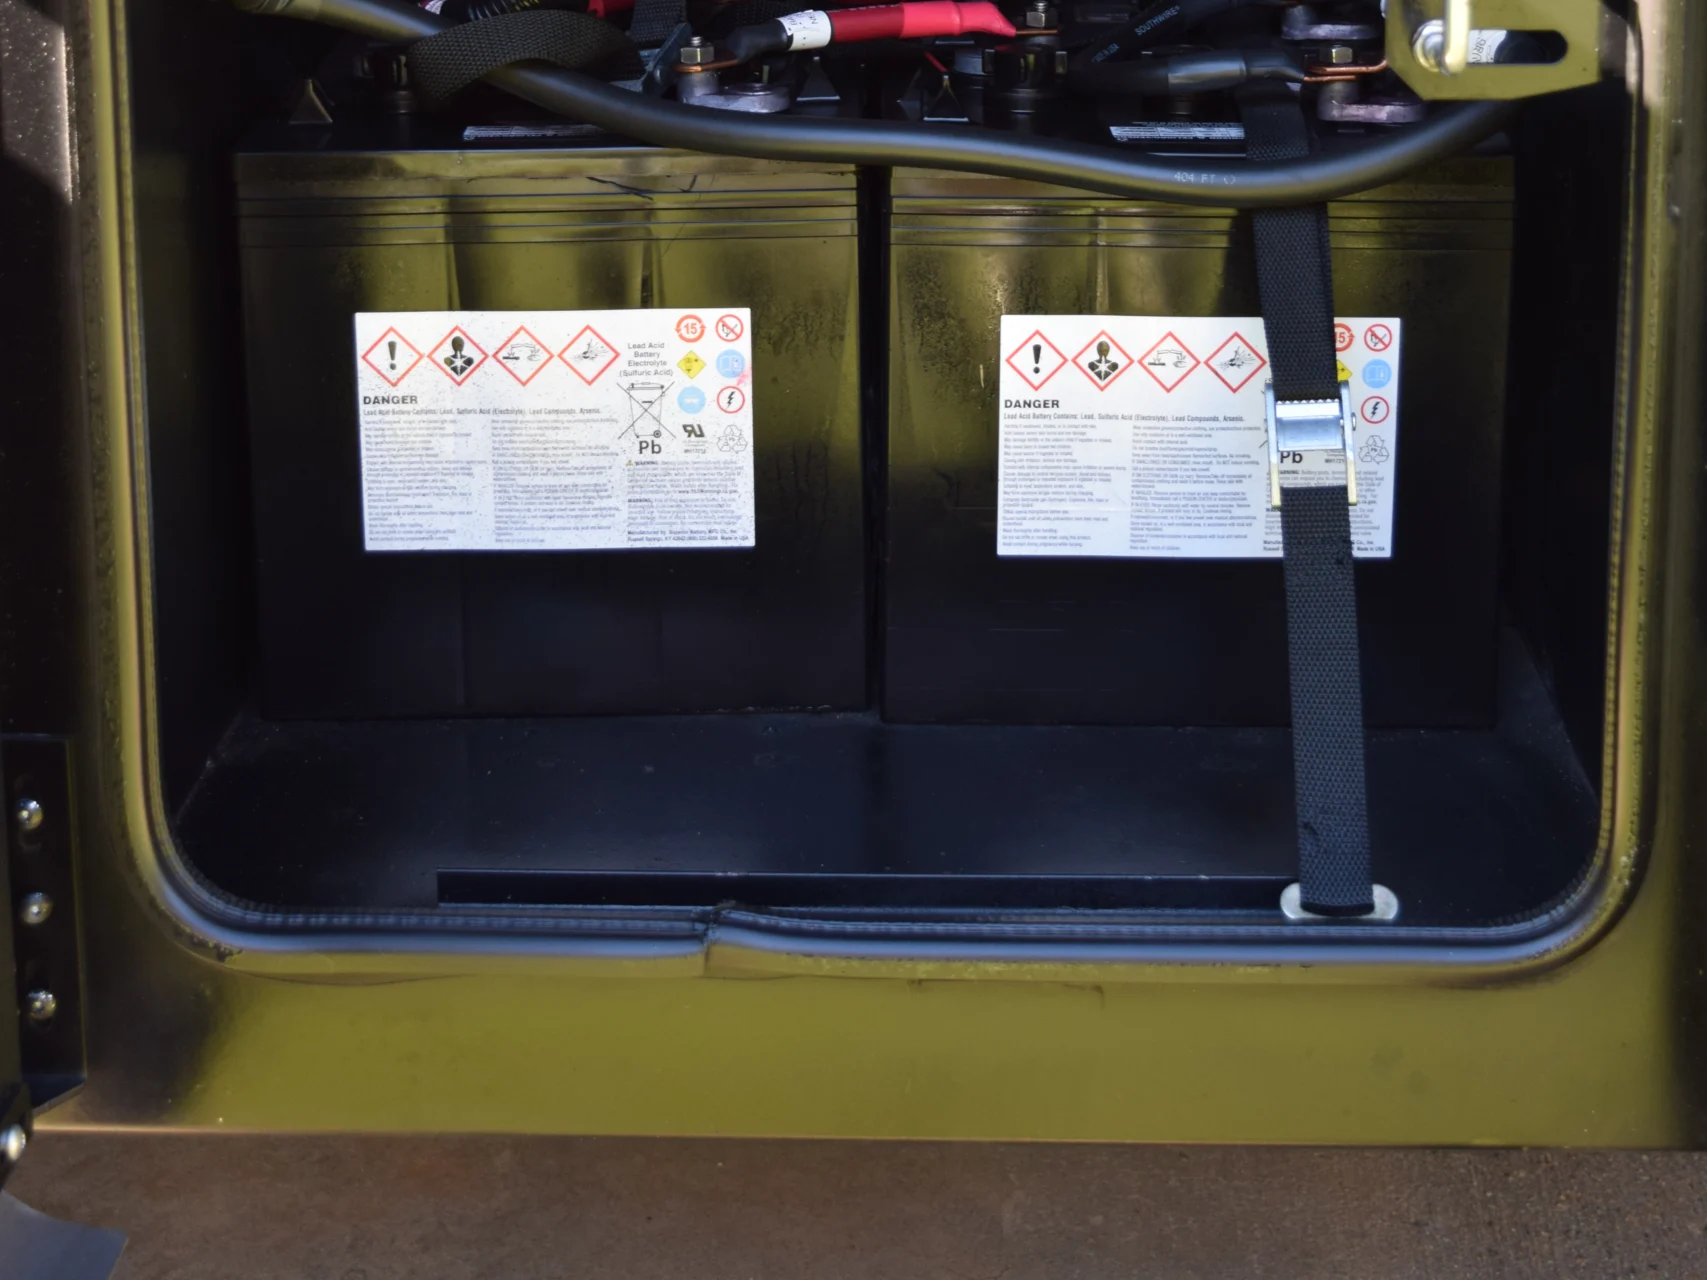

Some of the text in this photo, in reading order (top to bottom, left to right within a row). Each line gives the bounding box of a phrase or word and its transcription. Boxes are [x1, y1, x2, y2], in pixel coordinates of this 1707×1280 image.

[1201, 173, 1216, 184] FT
[684, 323, 698, 335] 15
[627, 360, 668, 368] Electrolyte
[619, 369, 674, 377] (Sulfuric Acid)
[362, 395, 418, 405] DANGER
[1004, 399, 1060, 408] DANGER
[638, 440, 662, 455] Pb
[1279, 451, 1303, 464] Pb
